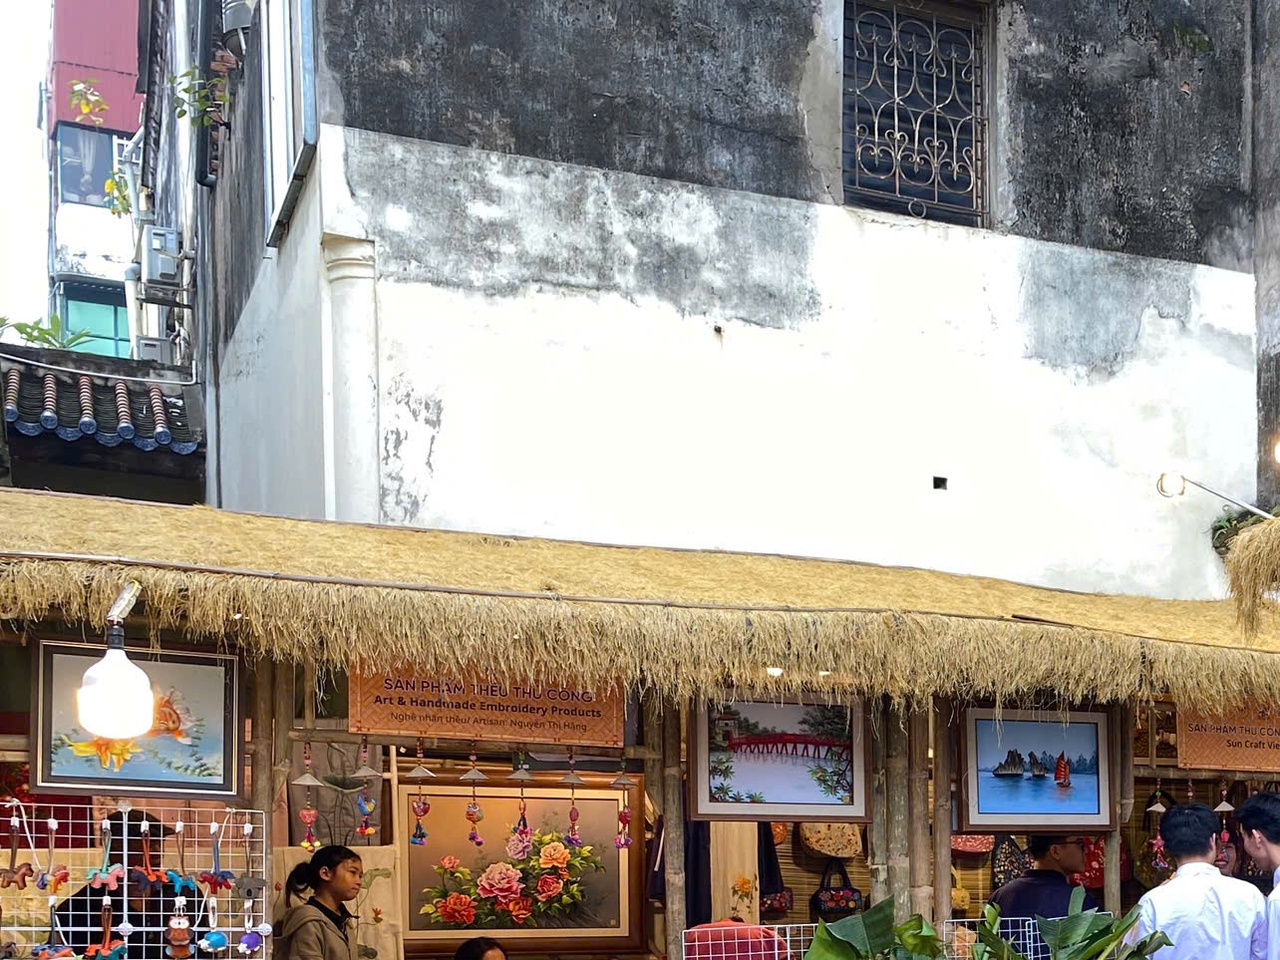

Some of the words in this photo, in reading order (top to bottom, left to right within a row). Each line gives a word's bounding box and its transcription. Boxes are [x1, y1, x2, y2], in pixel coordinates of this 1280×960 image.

[384, 676, 416, 691] SẢN
[547, 687, 593, 703] CÔNG
[374, 695, 394, 705] Art
[397, 696, 406, 706] &
[410, 697, 476, 710] Handmade
[480, 701, 548, 717] Embroidery
[551, 705, 602, 718] Products
[1226, 739, 1243, 749] Sun
[1245, 740, 1265, 749] Craft
